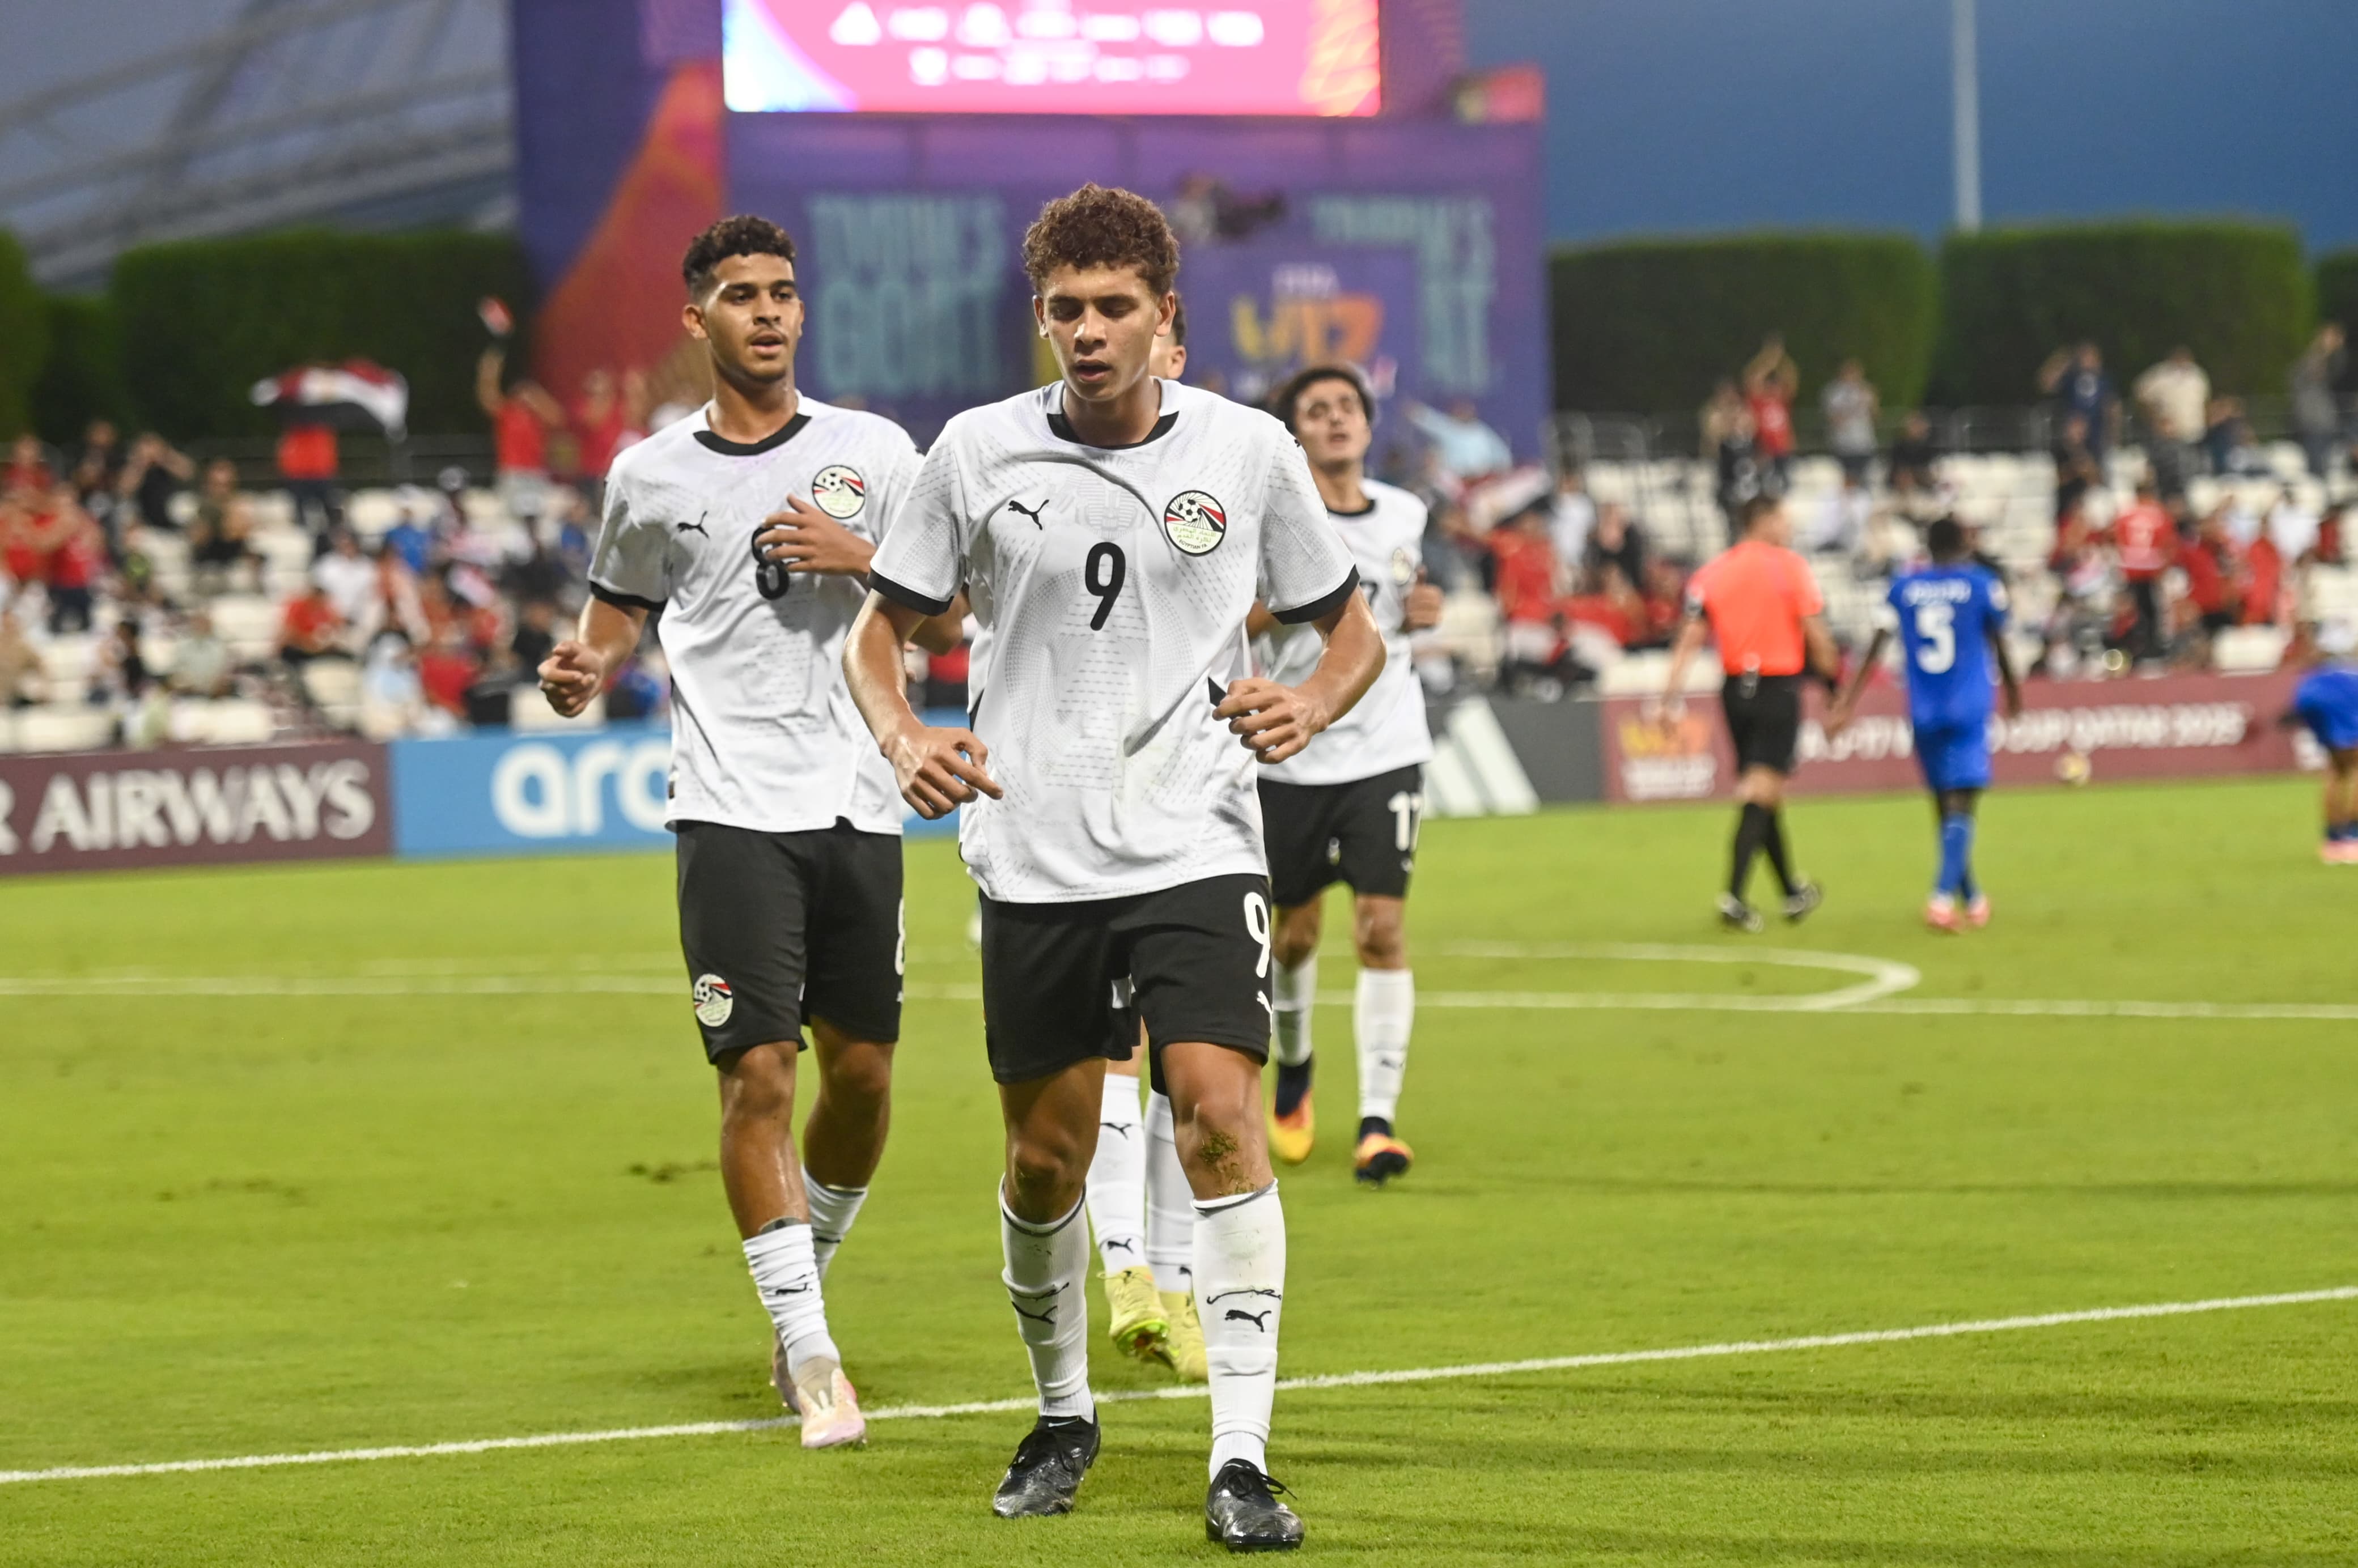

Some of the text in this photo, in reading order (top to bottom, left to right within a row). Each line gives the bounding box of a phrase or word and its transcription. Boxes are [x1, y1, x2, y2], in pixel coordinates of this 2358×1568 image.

[751, 526, 790, 600] 8
[1179, 539, 1201, 549] EGYPTIAN
[1085, 542, 1126, 631] 9
[1359, 579, 1380, 607] 7
[1915, 605, 1956, 674] 5
[31, 758, 375, 854] AIRWAYS
[1244, 891, 1271, 979] 9
